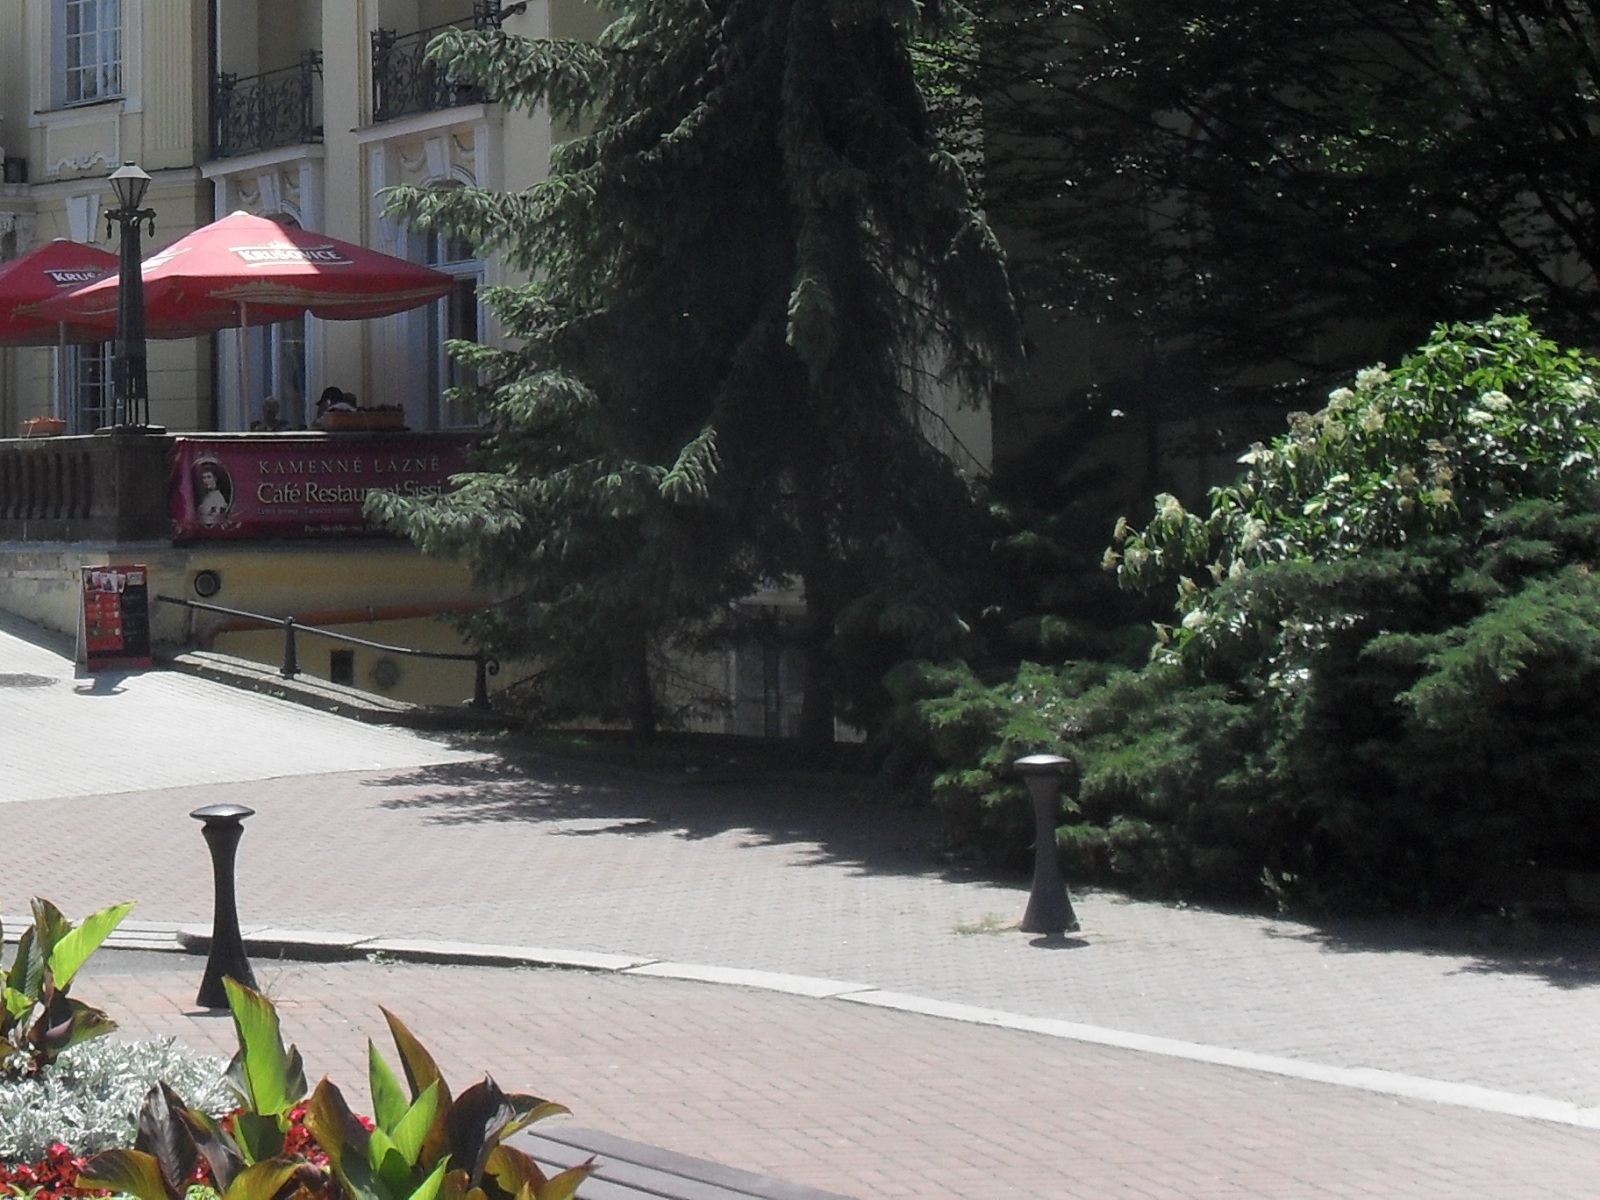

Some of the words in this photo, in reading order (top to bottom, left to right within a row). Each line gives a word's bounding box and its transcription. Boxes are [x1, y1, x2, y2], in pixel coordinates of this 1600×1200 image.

[258, 457, 363, 474] KAMENNÉ
[257, 482, 301, 504] Café
[305, 481, 401, 503] Restaut
[403, 479, 442, 499] Sissi
